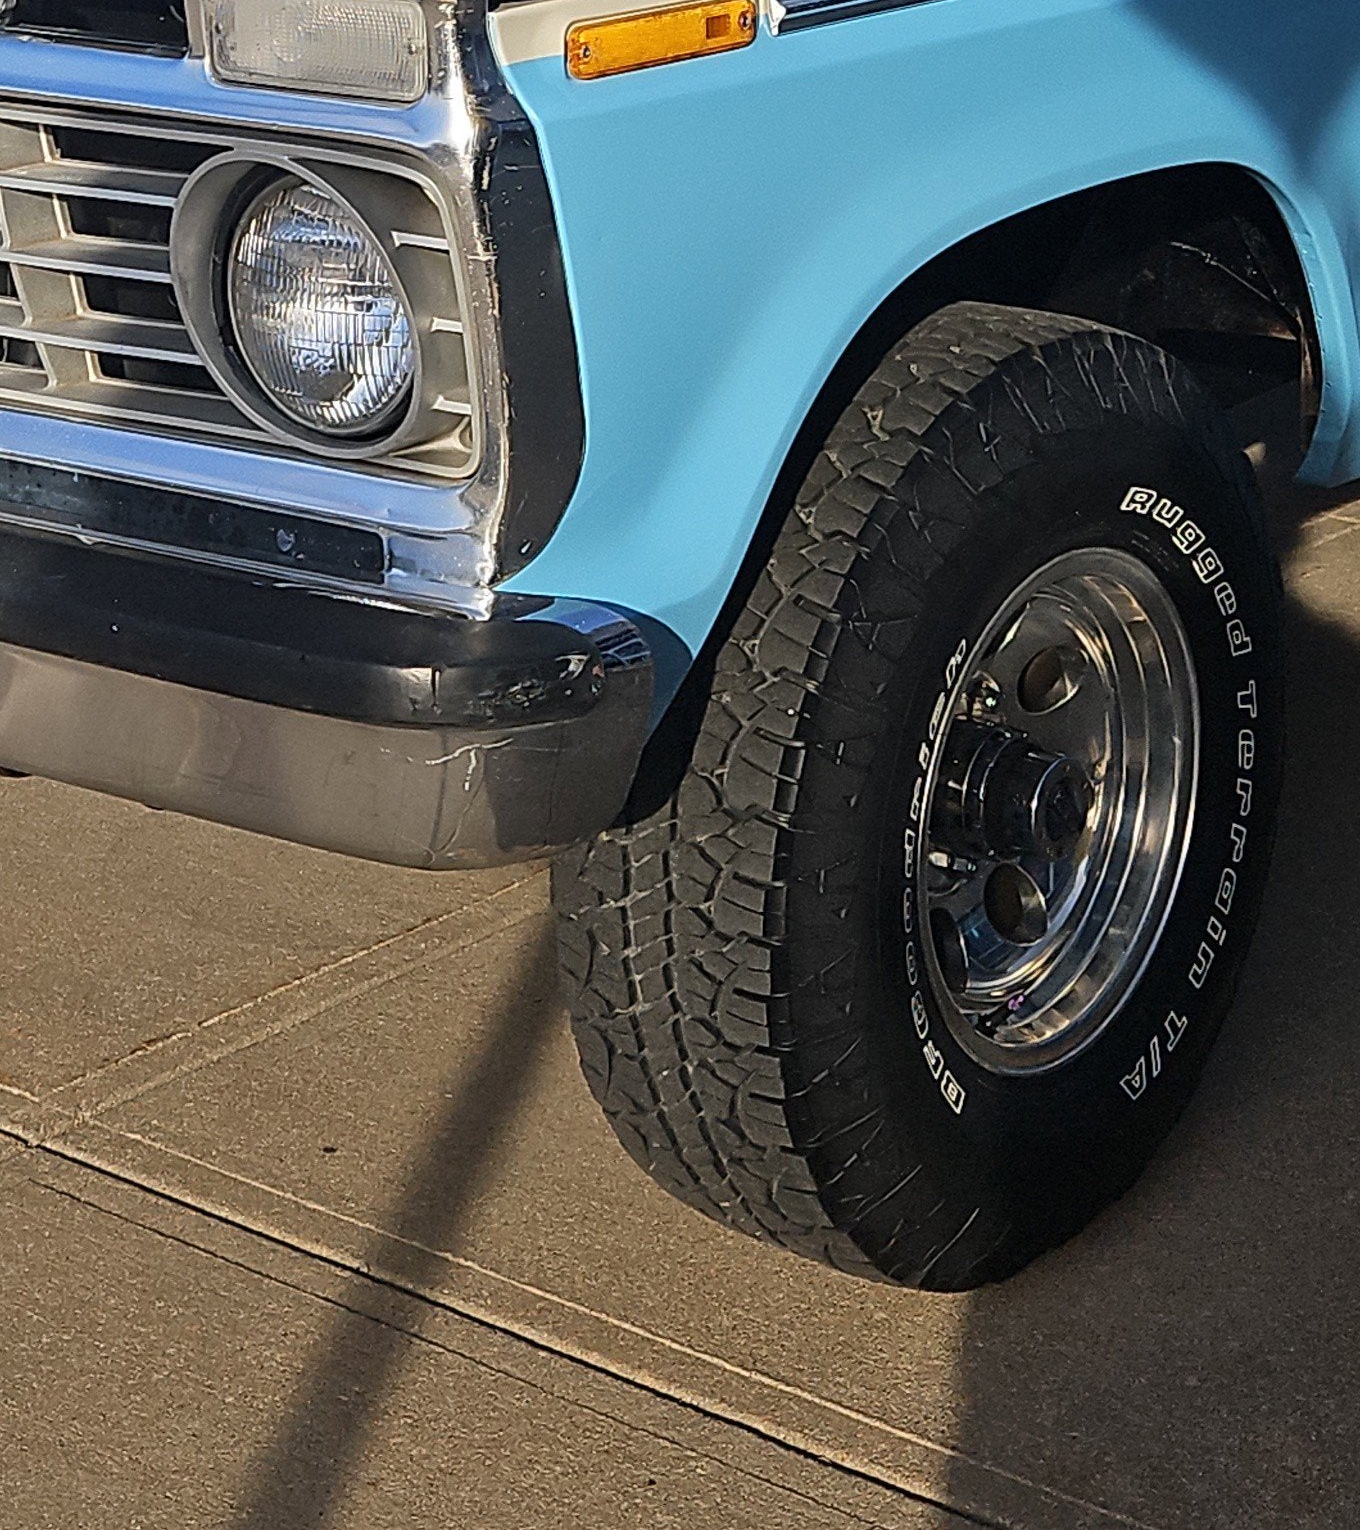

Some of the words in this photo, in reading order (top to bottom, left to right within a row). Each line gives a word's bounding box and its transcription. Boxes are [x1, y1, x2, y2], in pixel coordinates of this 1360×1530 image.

[1120, 486, 1252, 657] Rugged
[1189, 680, 1257, 989] Terrain
[1120, 1010, 1188, 1101] T/A
